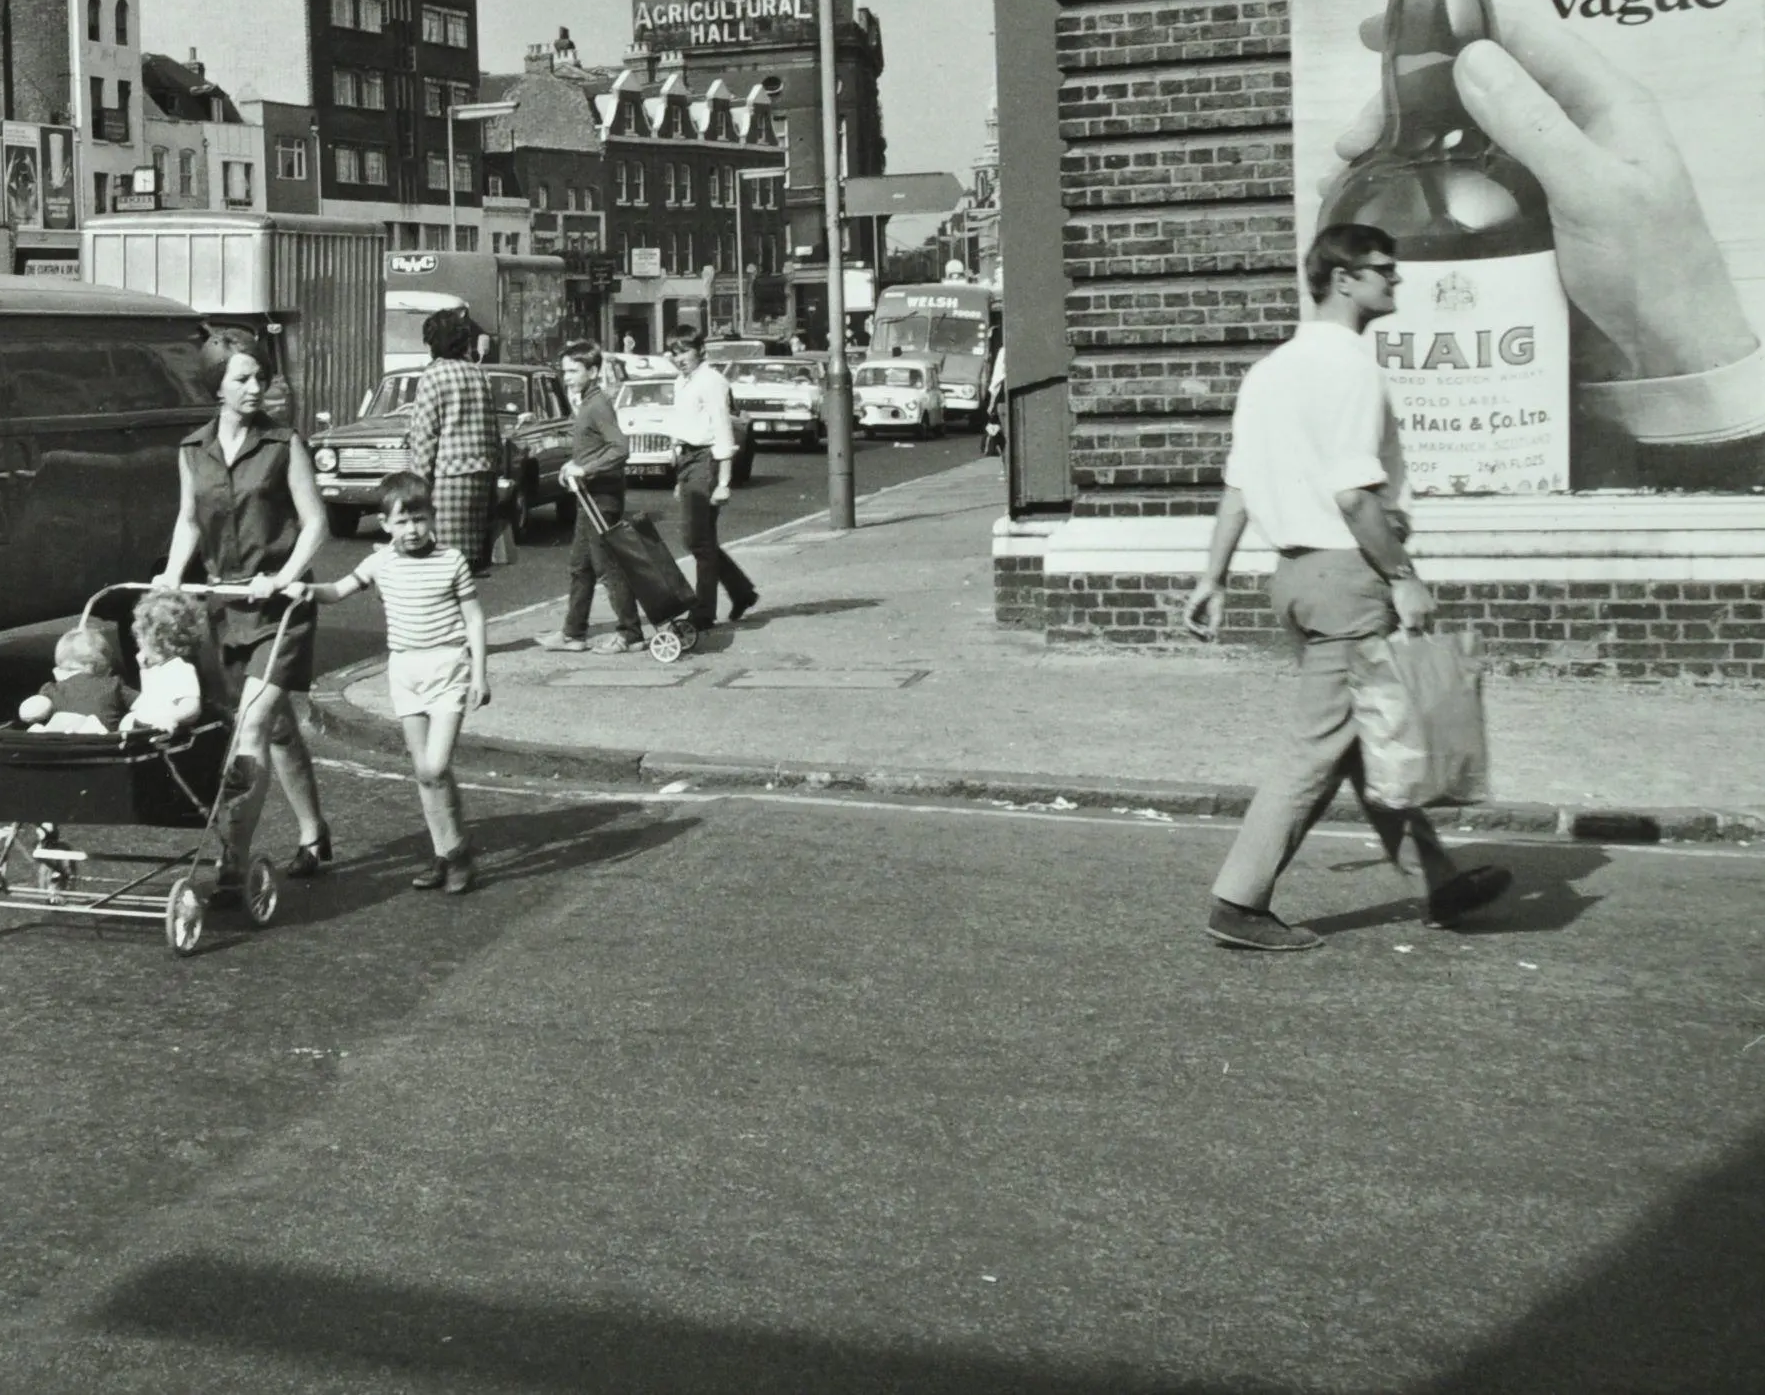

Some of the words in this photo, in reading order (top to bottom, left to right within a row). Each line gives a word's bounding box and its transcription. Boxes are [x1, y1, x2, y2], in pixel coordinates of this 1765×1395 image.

[691, 21, 753, 44] HALL
[907, 296, 958, 308] WELSH
[1375, 325, 1535, 370] HAIG
[1389, 376, 1426, 386] NDED
[1436, 375, 1490, 386] SCOTCH
[1404, 396, 1450, 408] GOLD
[1412, 413, 1461, 431] HAIG
[1470, 417, 1483, 431] &
[1404, 461, 1439, 473] ROOF
